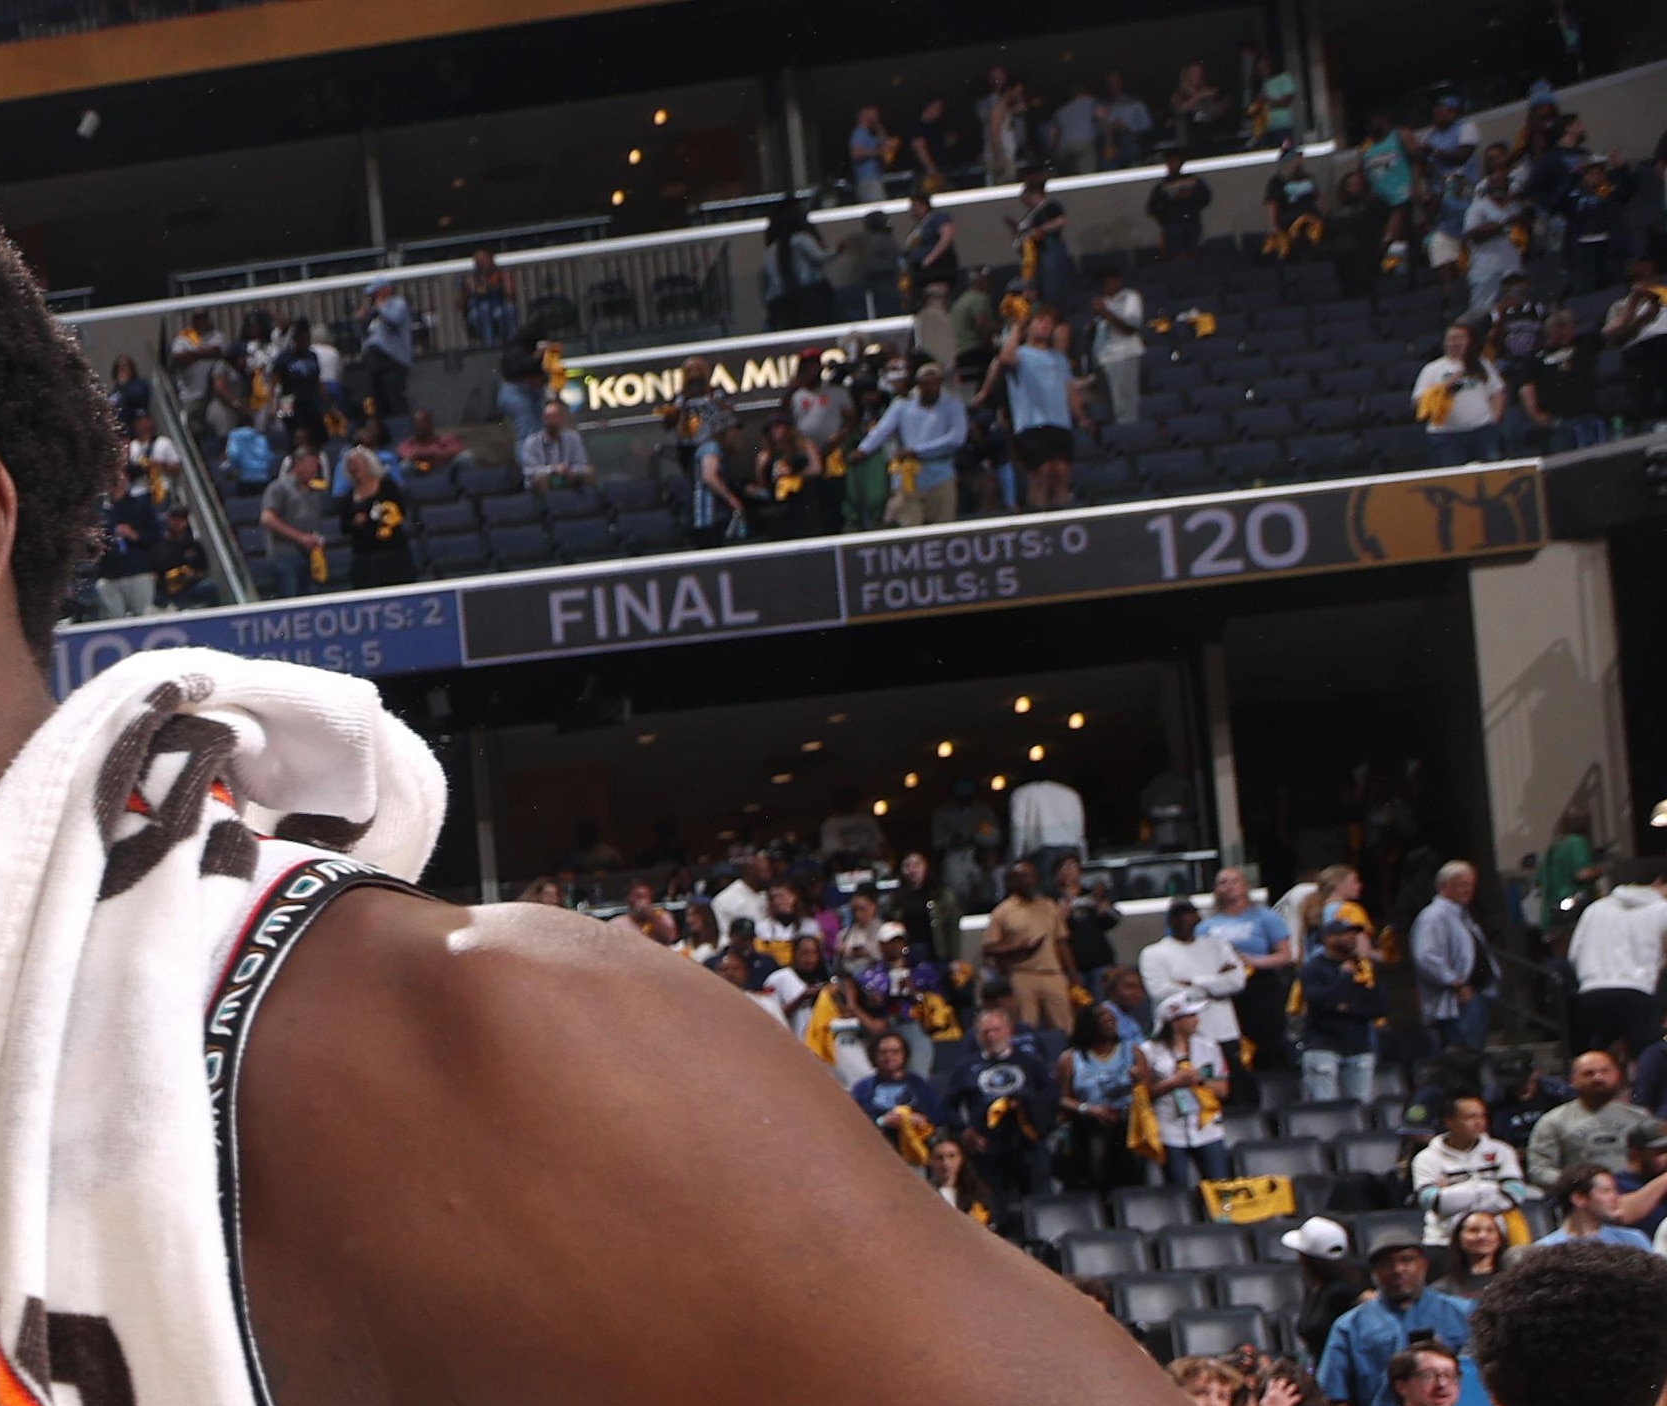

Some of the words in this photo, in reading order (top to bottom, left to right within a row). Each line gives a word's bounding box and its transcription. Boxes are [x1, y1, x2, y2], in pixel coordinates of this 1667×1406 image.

[857, 529, 1052, 574] TIMEOUTS:
[1059, 526, 1089, 555] 0
[1146, 500, 1309, 580] 120
[548, 571, 758, 645] FINAL
[861, 575, 989, 611] FOULS:
[995, 567, 1019, 597] 5
[230, 603, 414, 646] TIMEOUTS:
[420, 597, 444, 626] 2
[360, 640, 383, 670] 5
